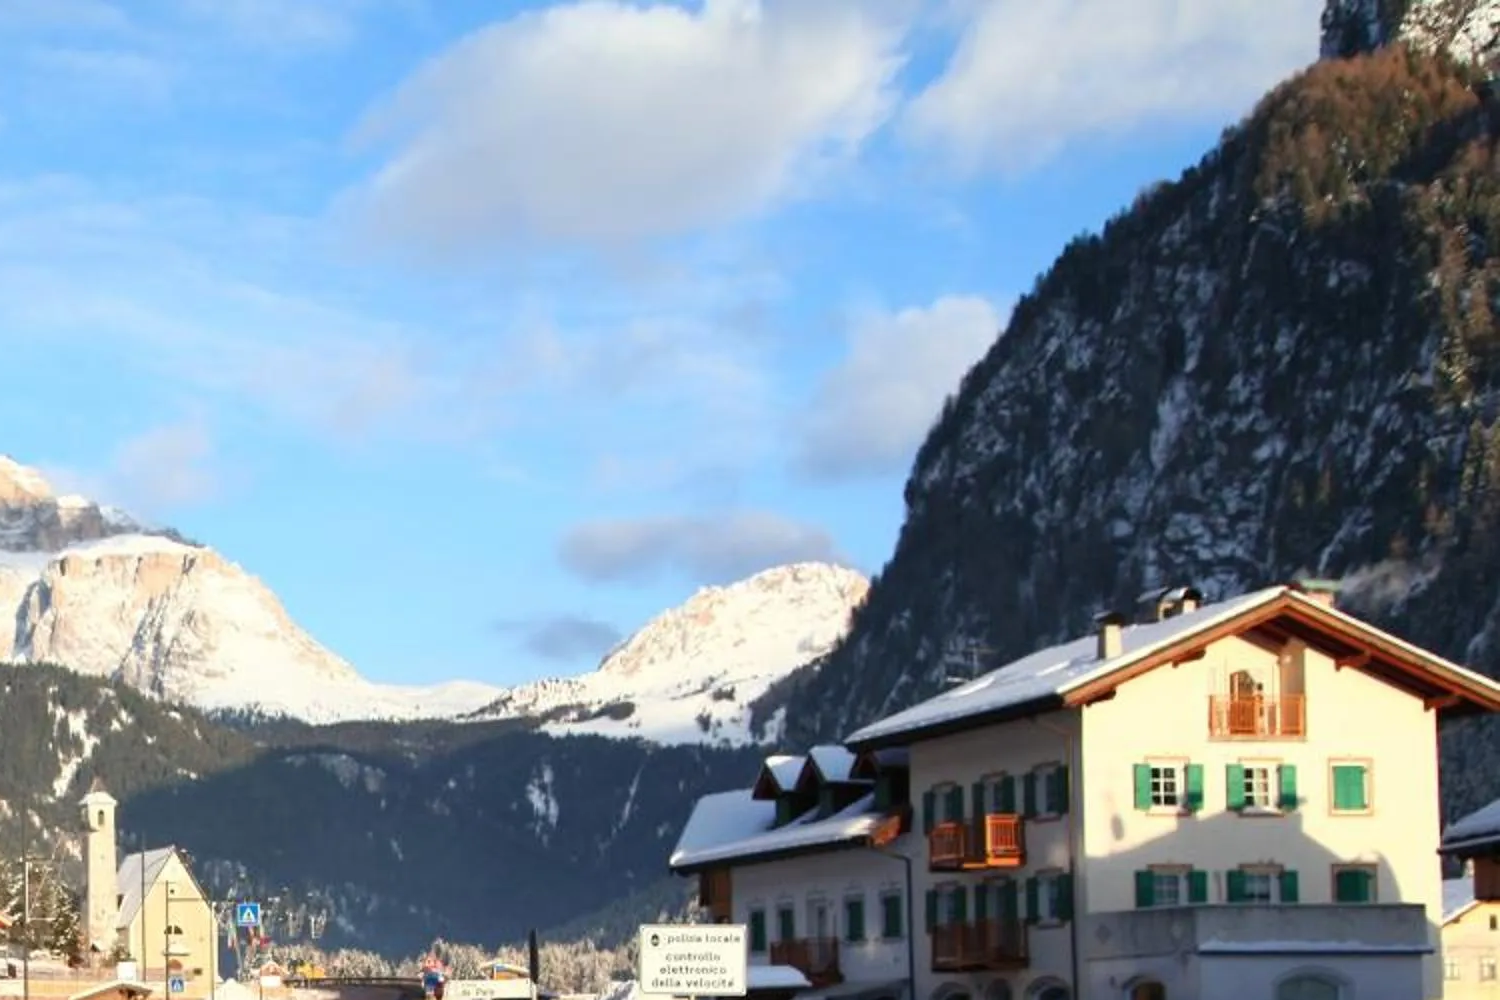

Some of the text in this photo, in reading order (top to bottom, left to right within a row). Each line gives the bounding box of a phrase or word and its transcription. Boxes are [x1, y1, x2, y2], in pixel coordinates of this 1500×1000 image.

[705, 933, 741, 943] locale
[665, 952, 722, 962] controllo
[659, 964, 728, 975] elettronico
[651, 977, 682, 988] della
